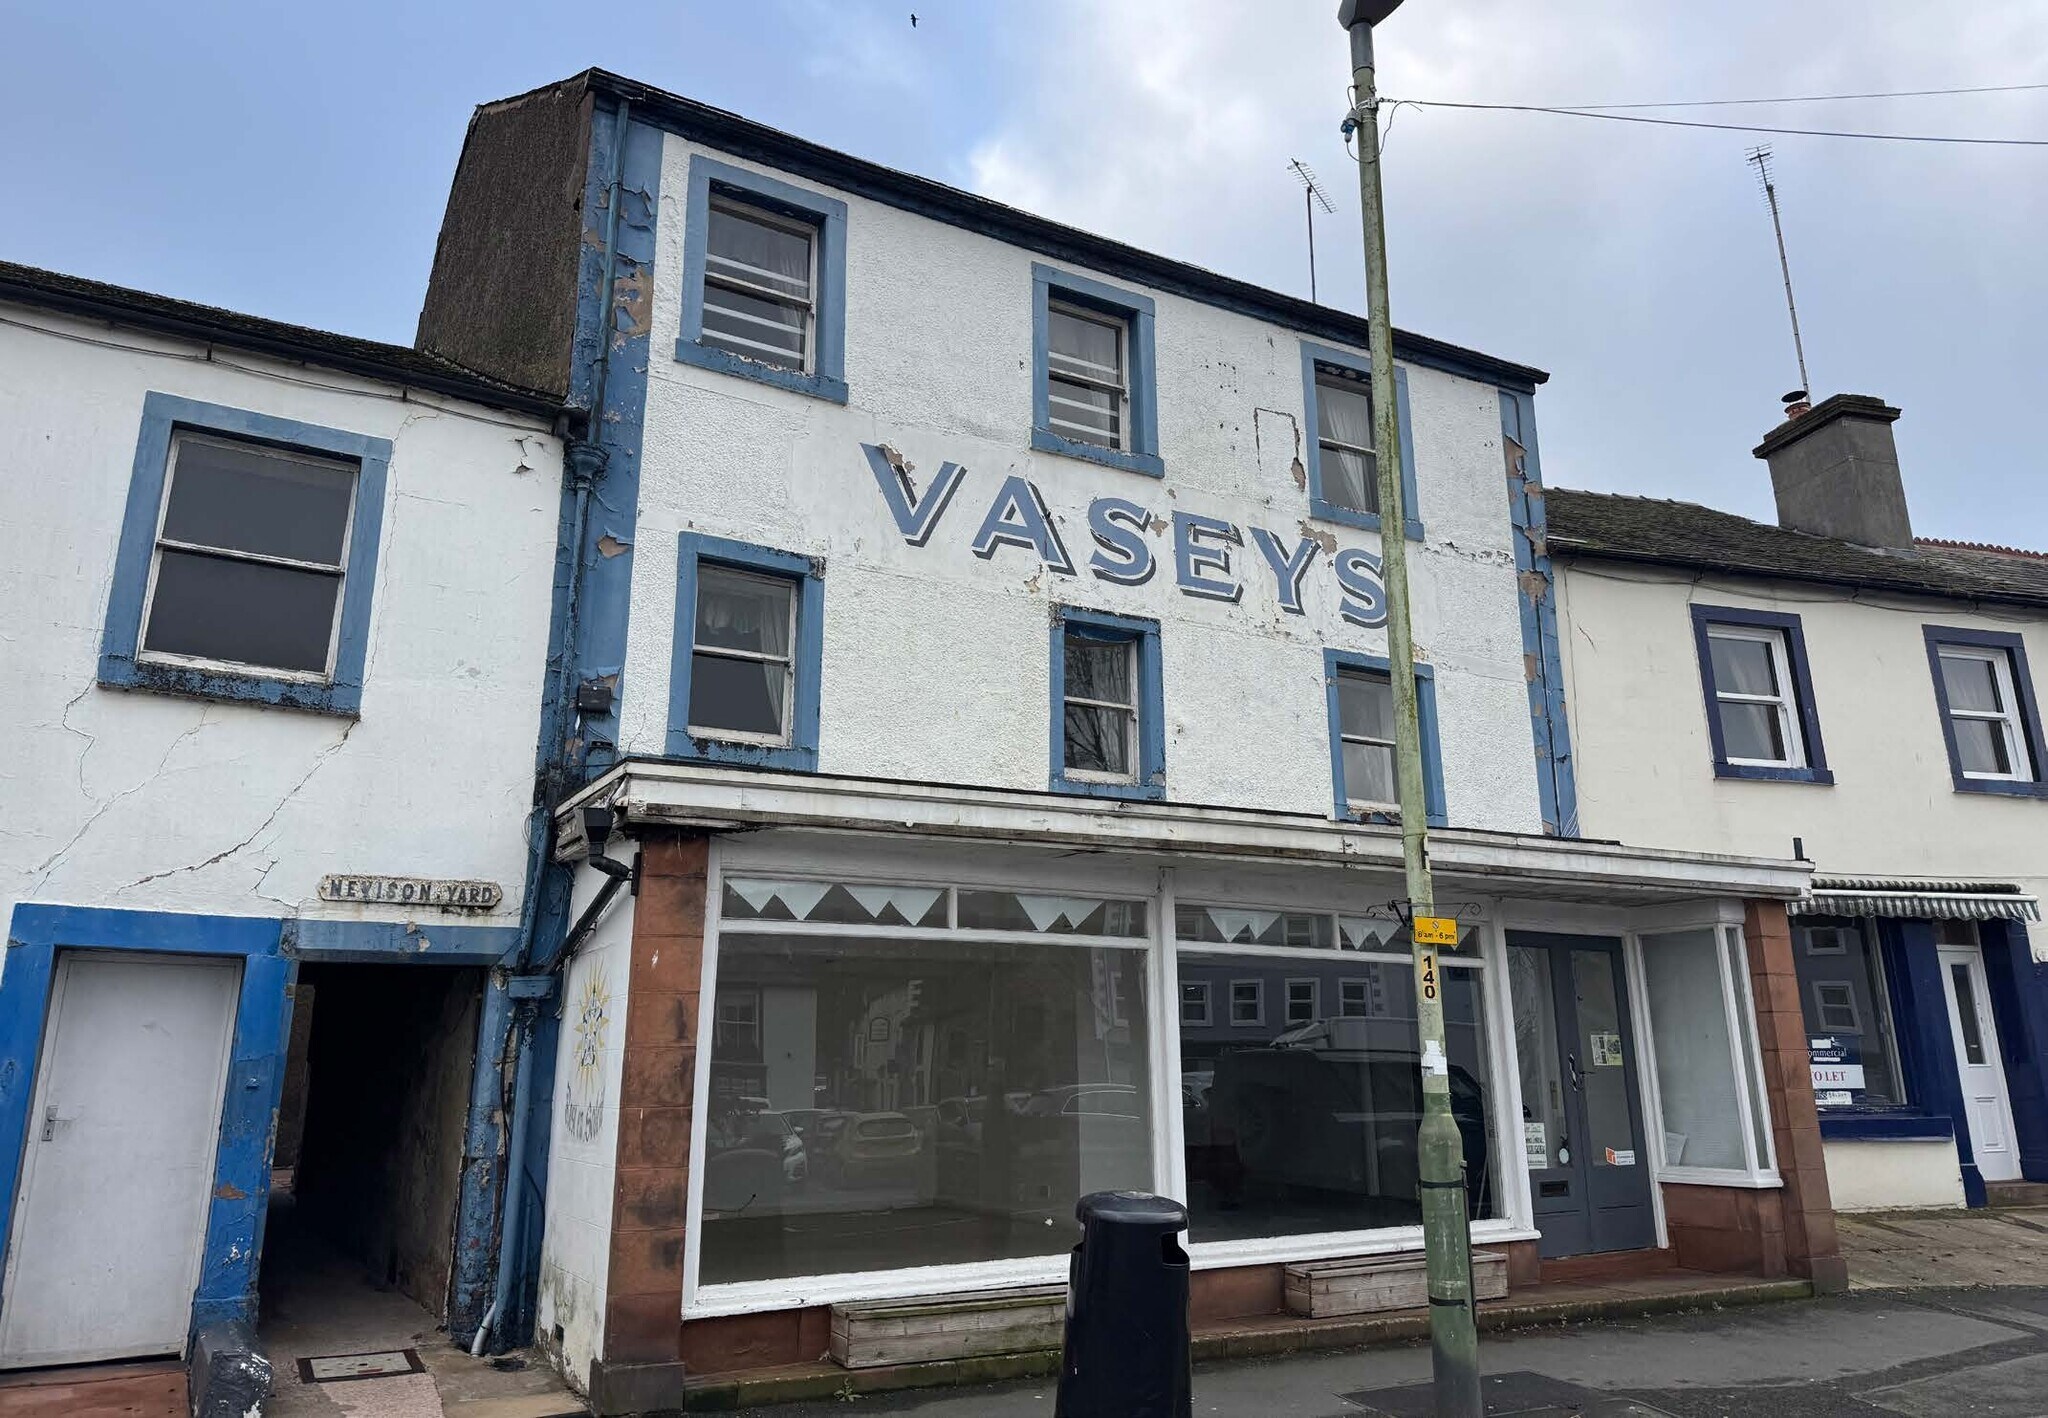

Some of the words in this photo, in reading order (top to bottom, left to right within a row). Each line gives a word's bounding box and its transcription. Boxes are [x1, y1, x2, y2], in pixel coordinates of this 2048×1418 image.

[448, 884, 494, 903] YARD
[1439, 932, 1444, 940] 6
[1423, 955, 1436, 999] 140
[1807, 1047, 1847, 1058] ommercial
[1825, 1070, 1846, 1081] LET
